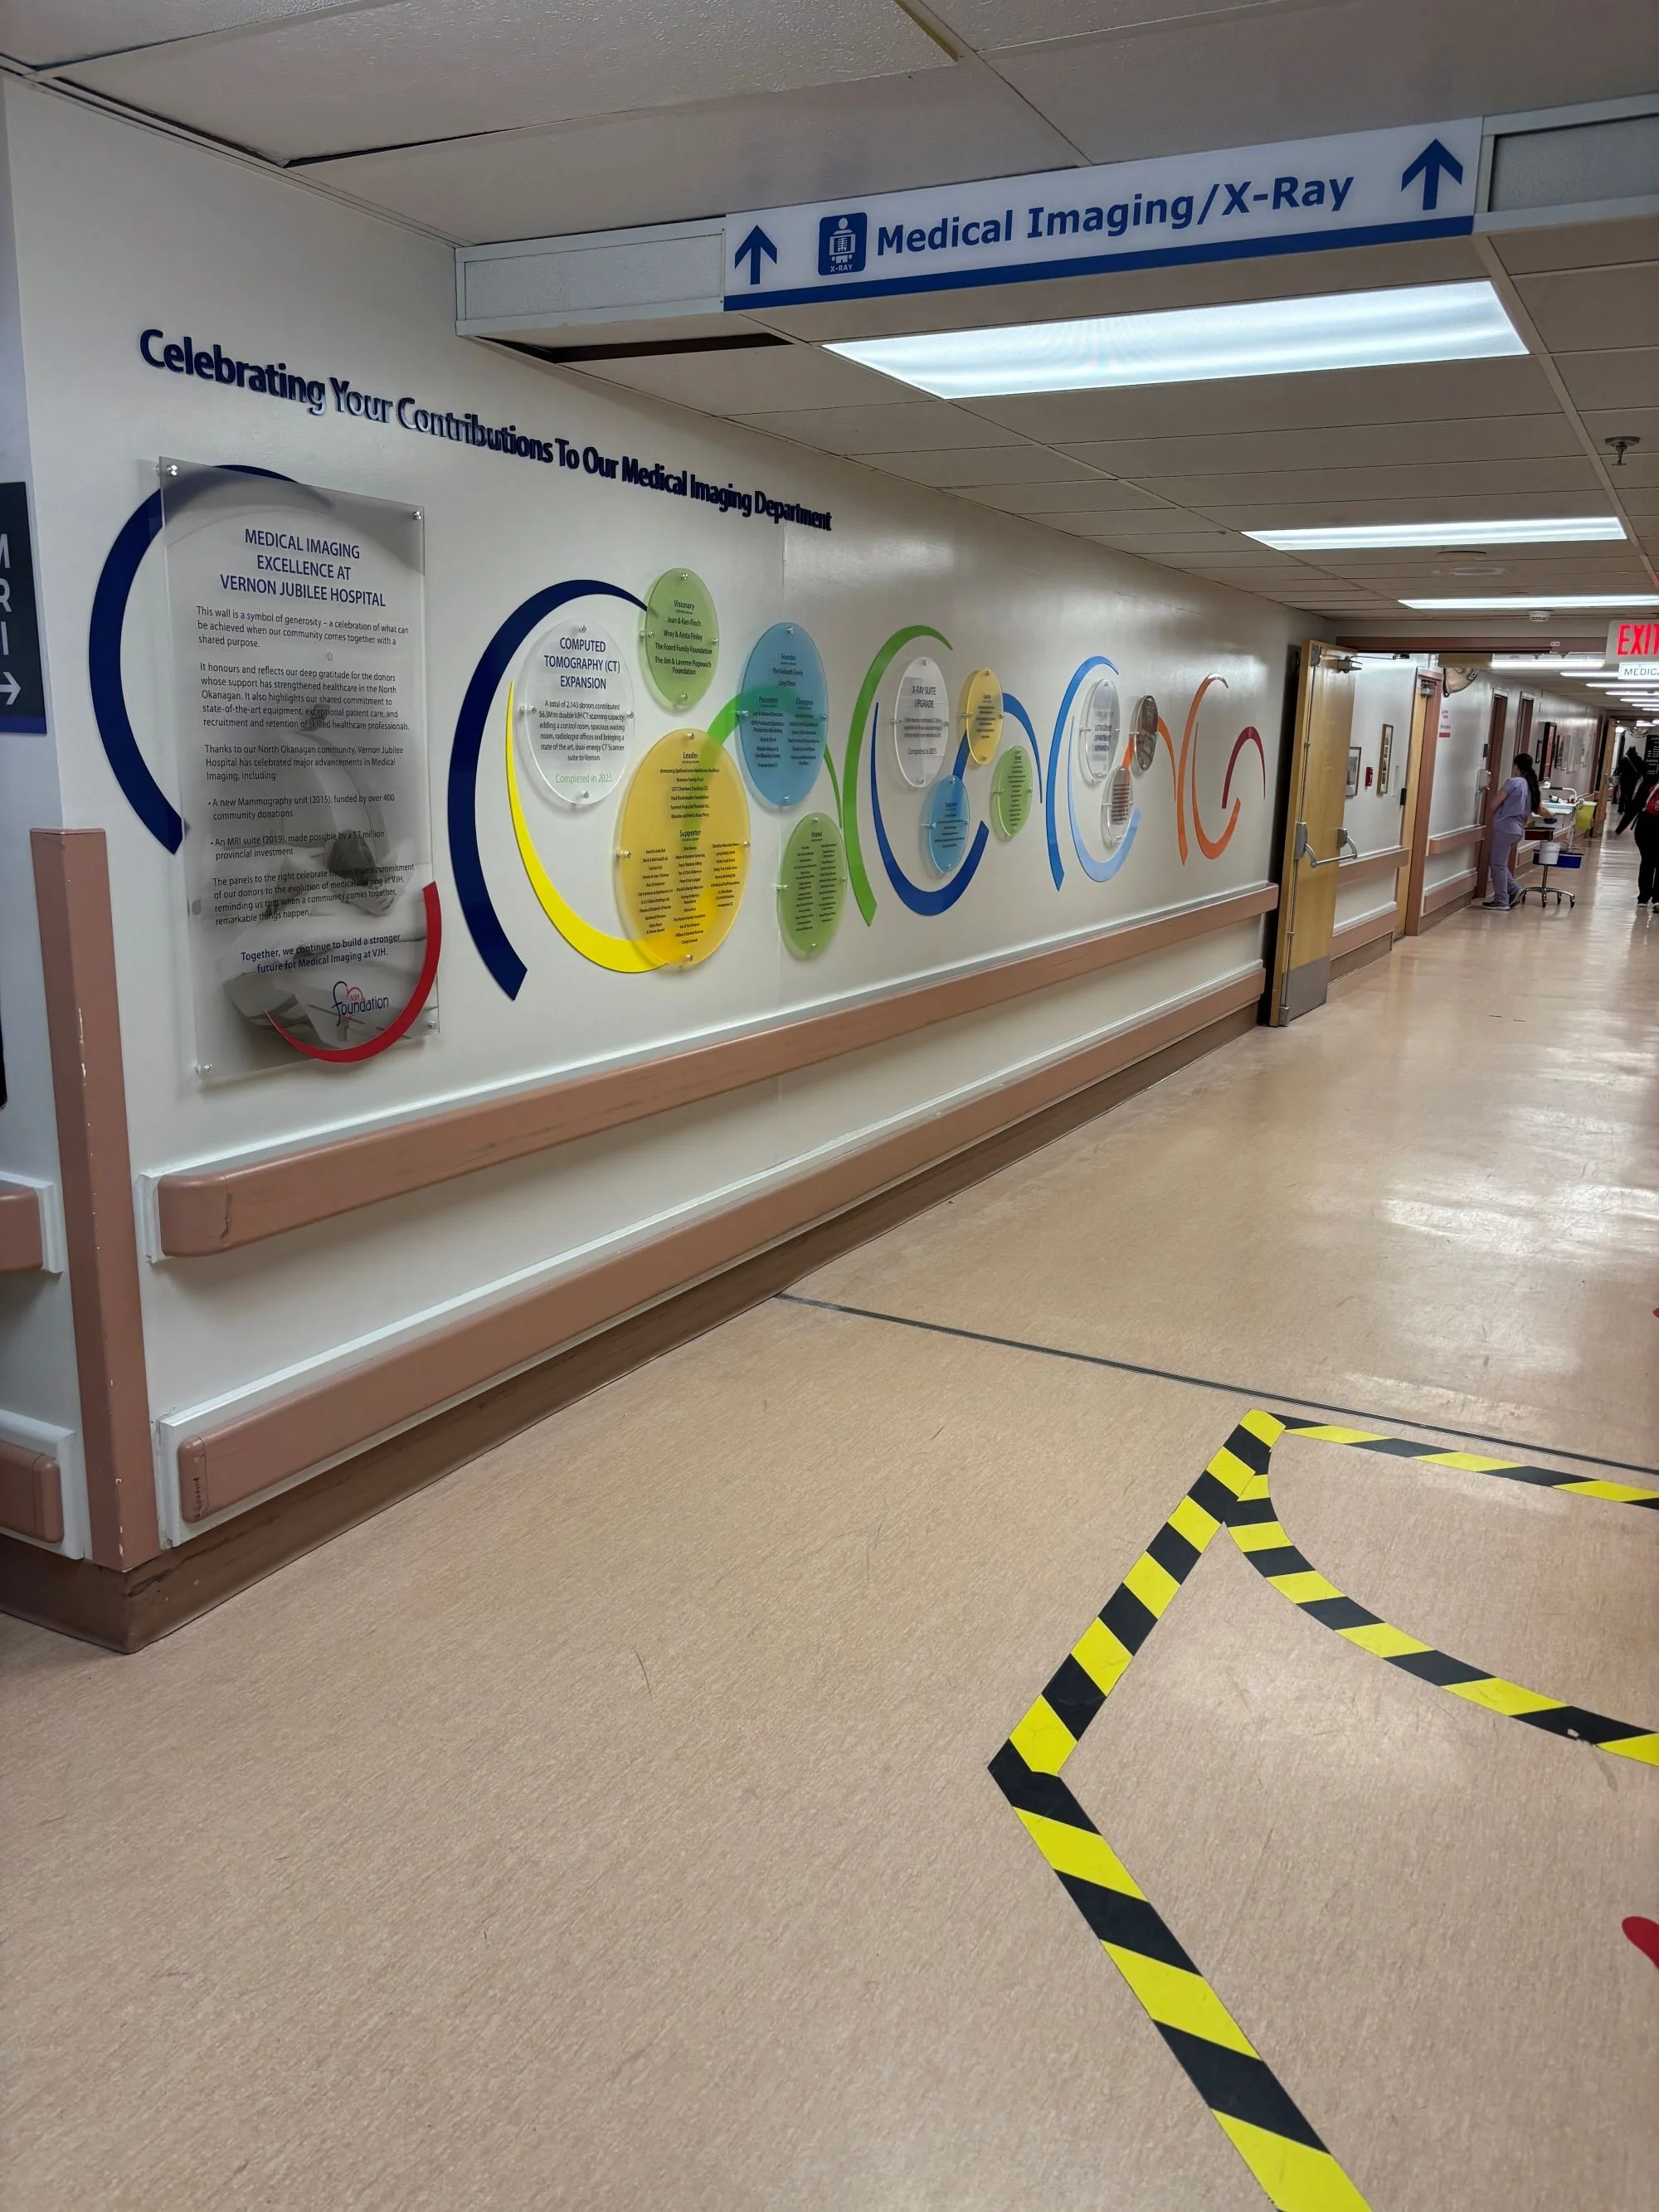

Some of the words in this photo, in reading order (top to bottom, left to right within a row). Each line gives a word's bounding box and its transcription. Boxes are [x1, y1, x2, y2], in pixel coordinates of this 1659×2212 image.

[878, 209, 1013, 255] Medical
[1027, 176, 1355, 238] Imaging/X-Ray
[830, 264, 853, 273] X-RAY
[139, 328, 326, 416] Celebrating
[329, 377, 393, 423] Your
[397, 396, 553, 463] Contributions
[554, 437, 580, 469] To
[582, 446, 619, 479] Our
[621, 455, 688, 496] Medical
[690, 474, 752, 518] Imaging
[754, 490, 832, 532] Department
[245, 528, 304, 551] MEDICAL
[306, 537, 360, 559] IMAGING
[257, 554, 334, 578] EXCELLENCE
[337, 566, 351, 581] AT
[220, 574, 276, 595] VERNON
[280, 581, 328, 600] JUBILEE
[330, 587, 386, 607] HOSPITAL
[674, 600, 695, 610] Visionary
[196, 605, 213, 616] This
[215, 608, 231, 618] wall
[232, 610, 239, 619] is
[246, 612, 274, 623] symbol
[275, 614, 283, 623] of
[285, 616, 322, 628] generosity
[334, 620, 372, 630] celebration
[381, 625, 397, 633] what
[197, 620, 207, 630] be
[210, 622, 245, 633] achieved
[246, 625, 267, 634] when
[283, 629, 323, 641] community
[324, 633, 346, 641] comes
[348, 634, 376, 644] together
[377, 636, 391, 644] with
[198, 634, 225, 645] shared
[226, 639, 260, 648] purpose.
[560, 637, 606, 653] COMPUTED
[544, 654, 603, 671] TOMOGRAPHY
[605, 659, 620, 673] (CT)
[200, 662, 206, 671] It
[208, 663, 241, 673] honours
[241, 665, 256, 674] and
[258, 665, 285, 676] reflects
[299, 668, 317, 679] deep
[319, 670, 350, 679] gratitude
[351, 671, 360, 679] for
[373, 673, 396, 682] donors
[1624, 668, 1659, 676] MEDIC
[201, 676, 226, 686] whose
[228, 679, 258, 688] support
[260, 679, 272, 688] has
[274, 680, 321, 691] strengthened
[323, 682, 358, 692] healthcare
[358, 683, 365, 692] in
[367, 684, 377, 693] the
[378, 685, 397, 694] North
[560, 675, 606, 689] EXPANSION
[202, 690, 243, 701] Okanagan.
[245, 691, 251, 701] It
[251, 692, 267, 701] also
[268, 693, 304, 703] highlights
[319, 695, 342, 703] shared
[343, 697, 385, 705] commitment
[912, 685, 924, 695] X-RAY
[925, 687, 937, 696] SUITE
[914, 699, 934, 708] UPGRADE
[202, 704, 261, 714] state-of-the-art
[263, 707, 304, 716] equipment,
[304, 707, 344, 717] exceptional
[345, 709, 369, 718] patient
[203, 717, 248, 727] recruitment
[250, 718, 264, 727] and
[265, 720, 299, 728] retention
[300, 719, 308, 728] of
[309, 720, 331, 728] skilled
[332, 720, 367, 729] healthcare
[367, 722, 411, 731] professionals.
[204, 744, 232, 753] Thanks
[258, 745, 279, 754] North
[280, 745, 316, 756] Okanagan
[317, 746, 357, 756] community,
[358, 746, 380, 754] Vernon
[381, 746, 404, 754] Jubilee
[206, 757, 237, 768] Hospital
[239, 757, 252, 766] has
[253, 757, 292, 766] celebrated
[294, 758, 314, 768] major
[314, 758, 362, 766] advancements
[372, 757, 397, 766] Medical
[206, 771, 240, 782] Imaging,
[241, 771, 278, 781] including:
[555, 773, 590, 785] Completed
[591, 774, 597, 783] in
[679, 829, 701, 838] Supporter
[241, 949, 280, 962] Together,
[282, 947, 294, 955] we
[296, 943, 331, 954] continue
[342, 937, 362, 947] build
[369, 934, 400, 946] stronger
[257, 962, 283, 974] future
[285, 961, 297, 970] for
[298, 955, 329, 967] Medical
[331, 952, 362, 963] Imaging
[372, 948, 388, 957] VJH.
